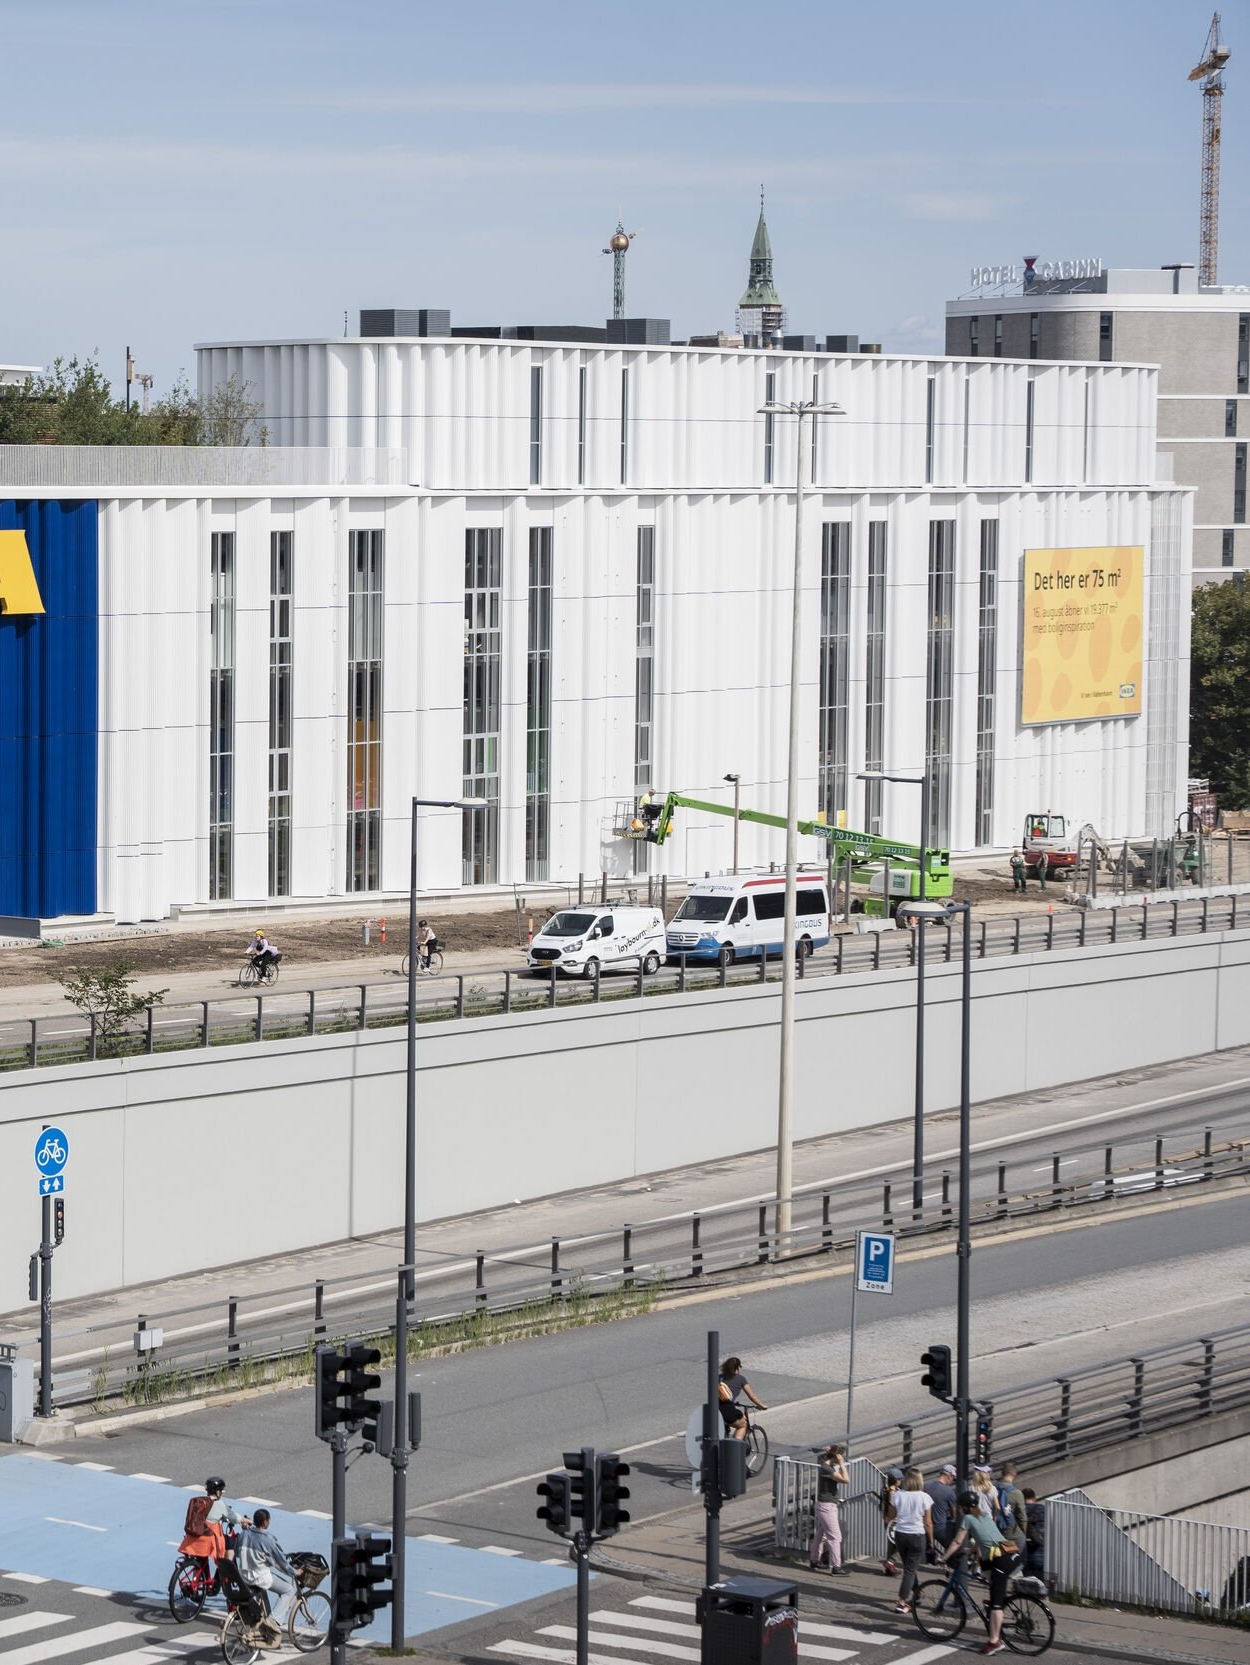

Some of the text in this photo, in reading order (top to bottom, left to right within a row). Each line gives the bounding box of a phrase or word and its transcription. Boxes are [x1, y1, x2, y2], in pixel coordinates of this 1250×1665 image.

[970, 257, 1102, 287] HOTEL CABINN
[1034, 572, 1054, 591] Det
[1056, 570, 1075, 590] her
[1078, 574, 1090, 589] er
[1092, 569, 1105, 588] 75
[1042, 606, 1064, 621] august
[1065, 604, 1083, 617] åbner
[1033, 621, 1046, 634] med
[814, 827, 831, 838] GSV
[835, 830, 844, 840] 70
[869, 1240, 885, 1261] P
[866, 1282, 884, 1290] Zone
